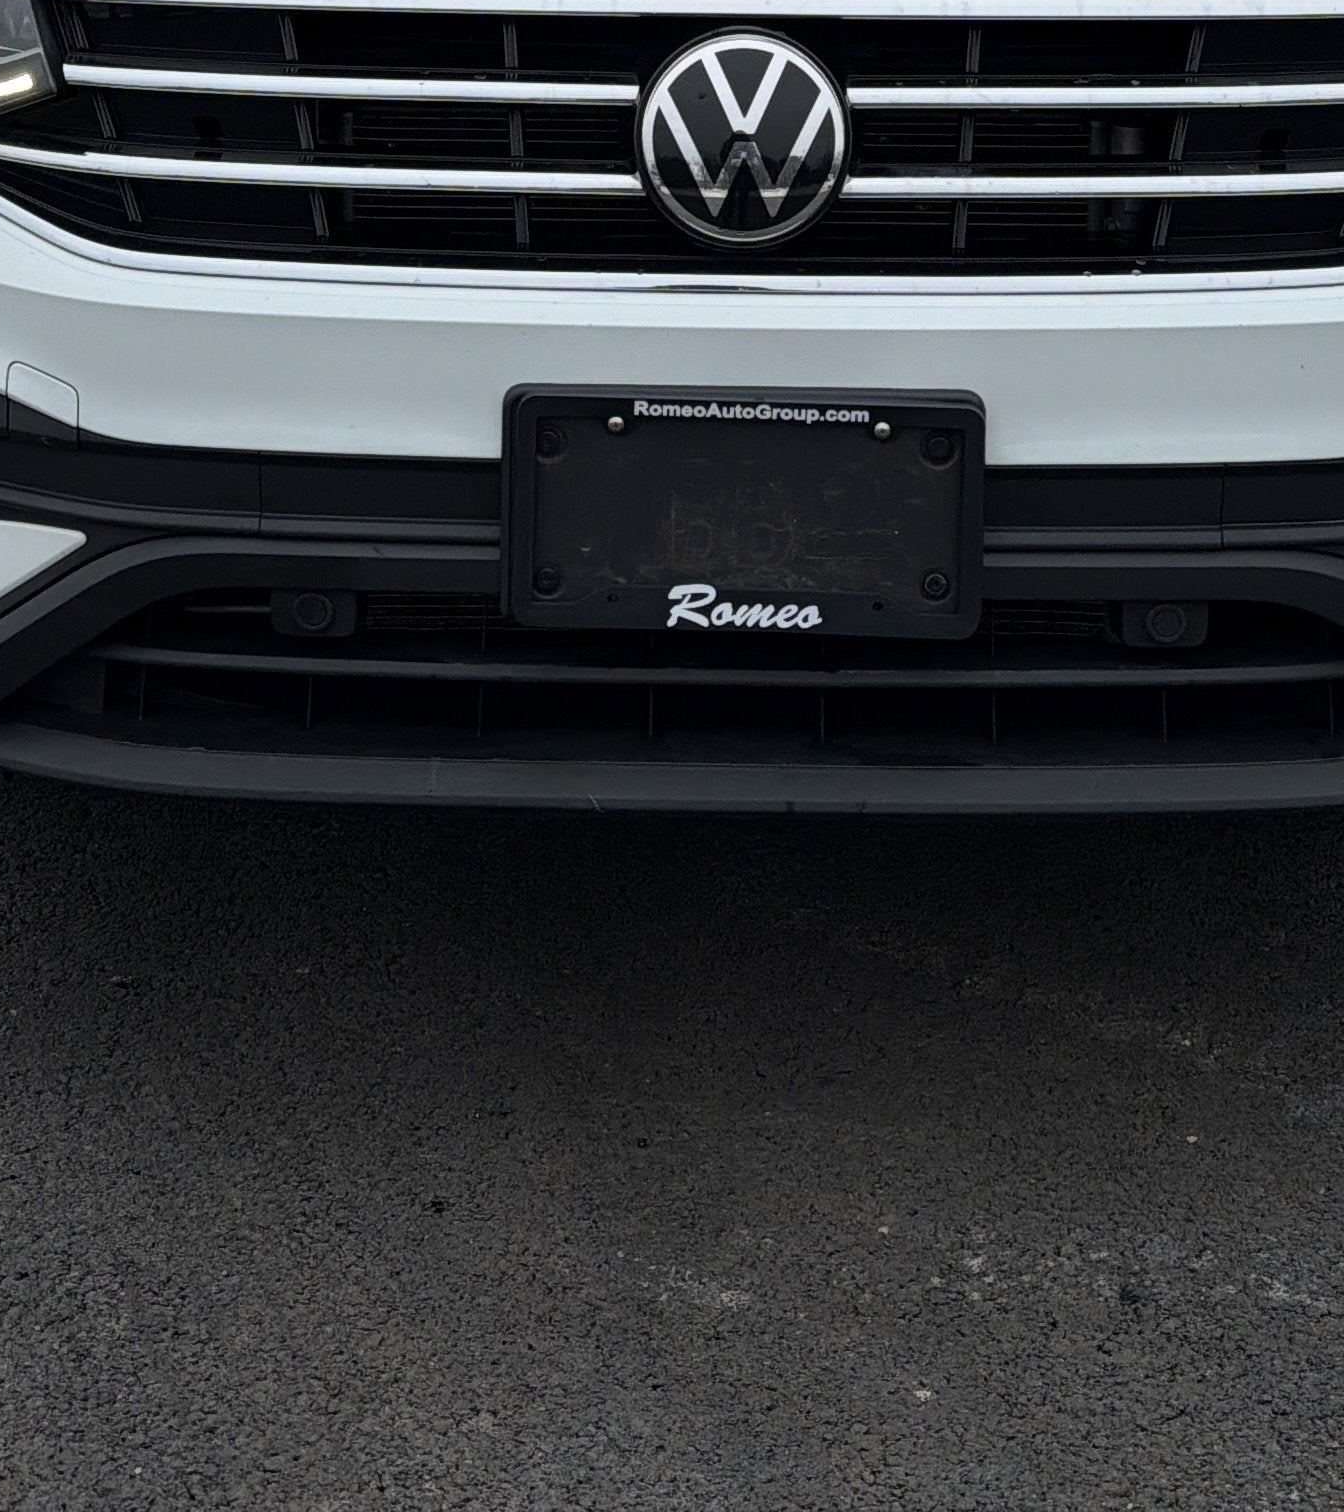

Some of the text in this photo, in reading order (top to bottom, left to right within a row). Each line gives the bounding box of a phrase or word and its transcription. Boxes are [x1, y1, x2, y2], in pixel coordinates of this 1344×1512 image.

[648, 40, 840, 228] VW
[633, 399, 870, 425] RomeoAutoGroup.com
[666, 583, 823, 630] Romeo
